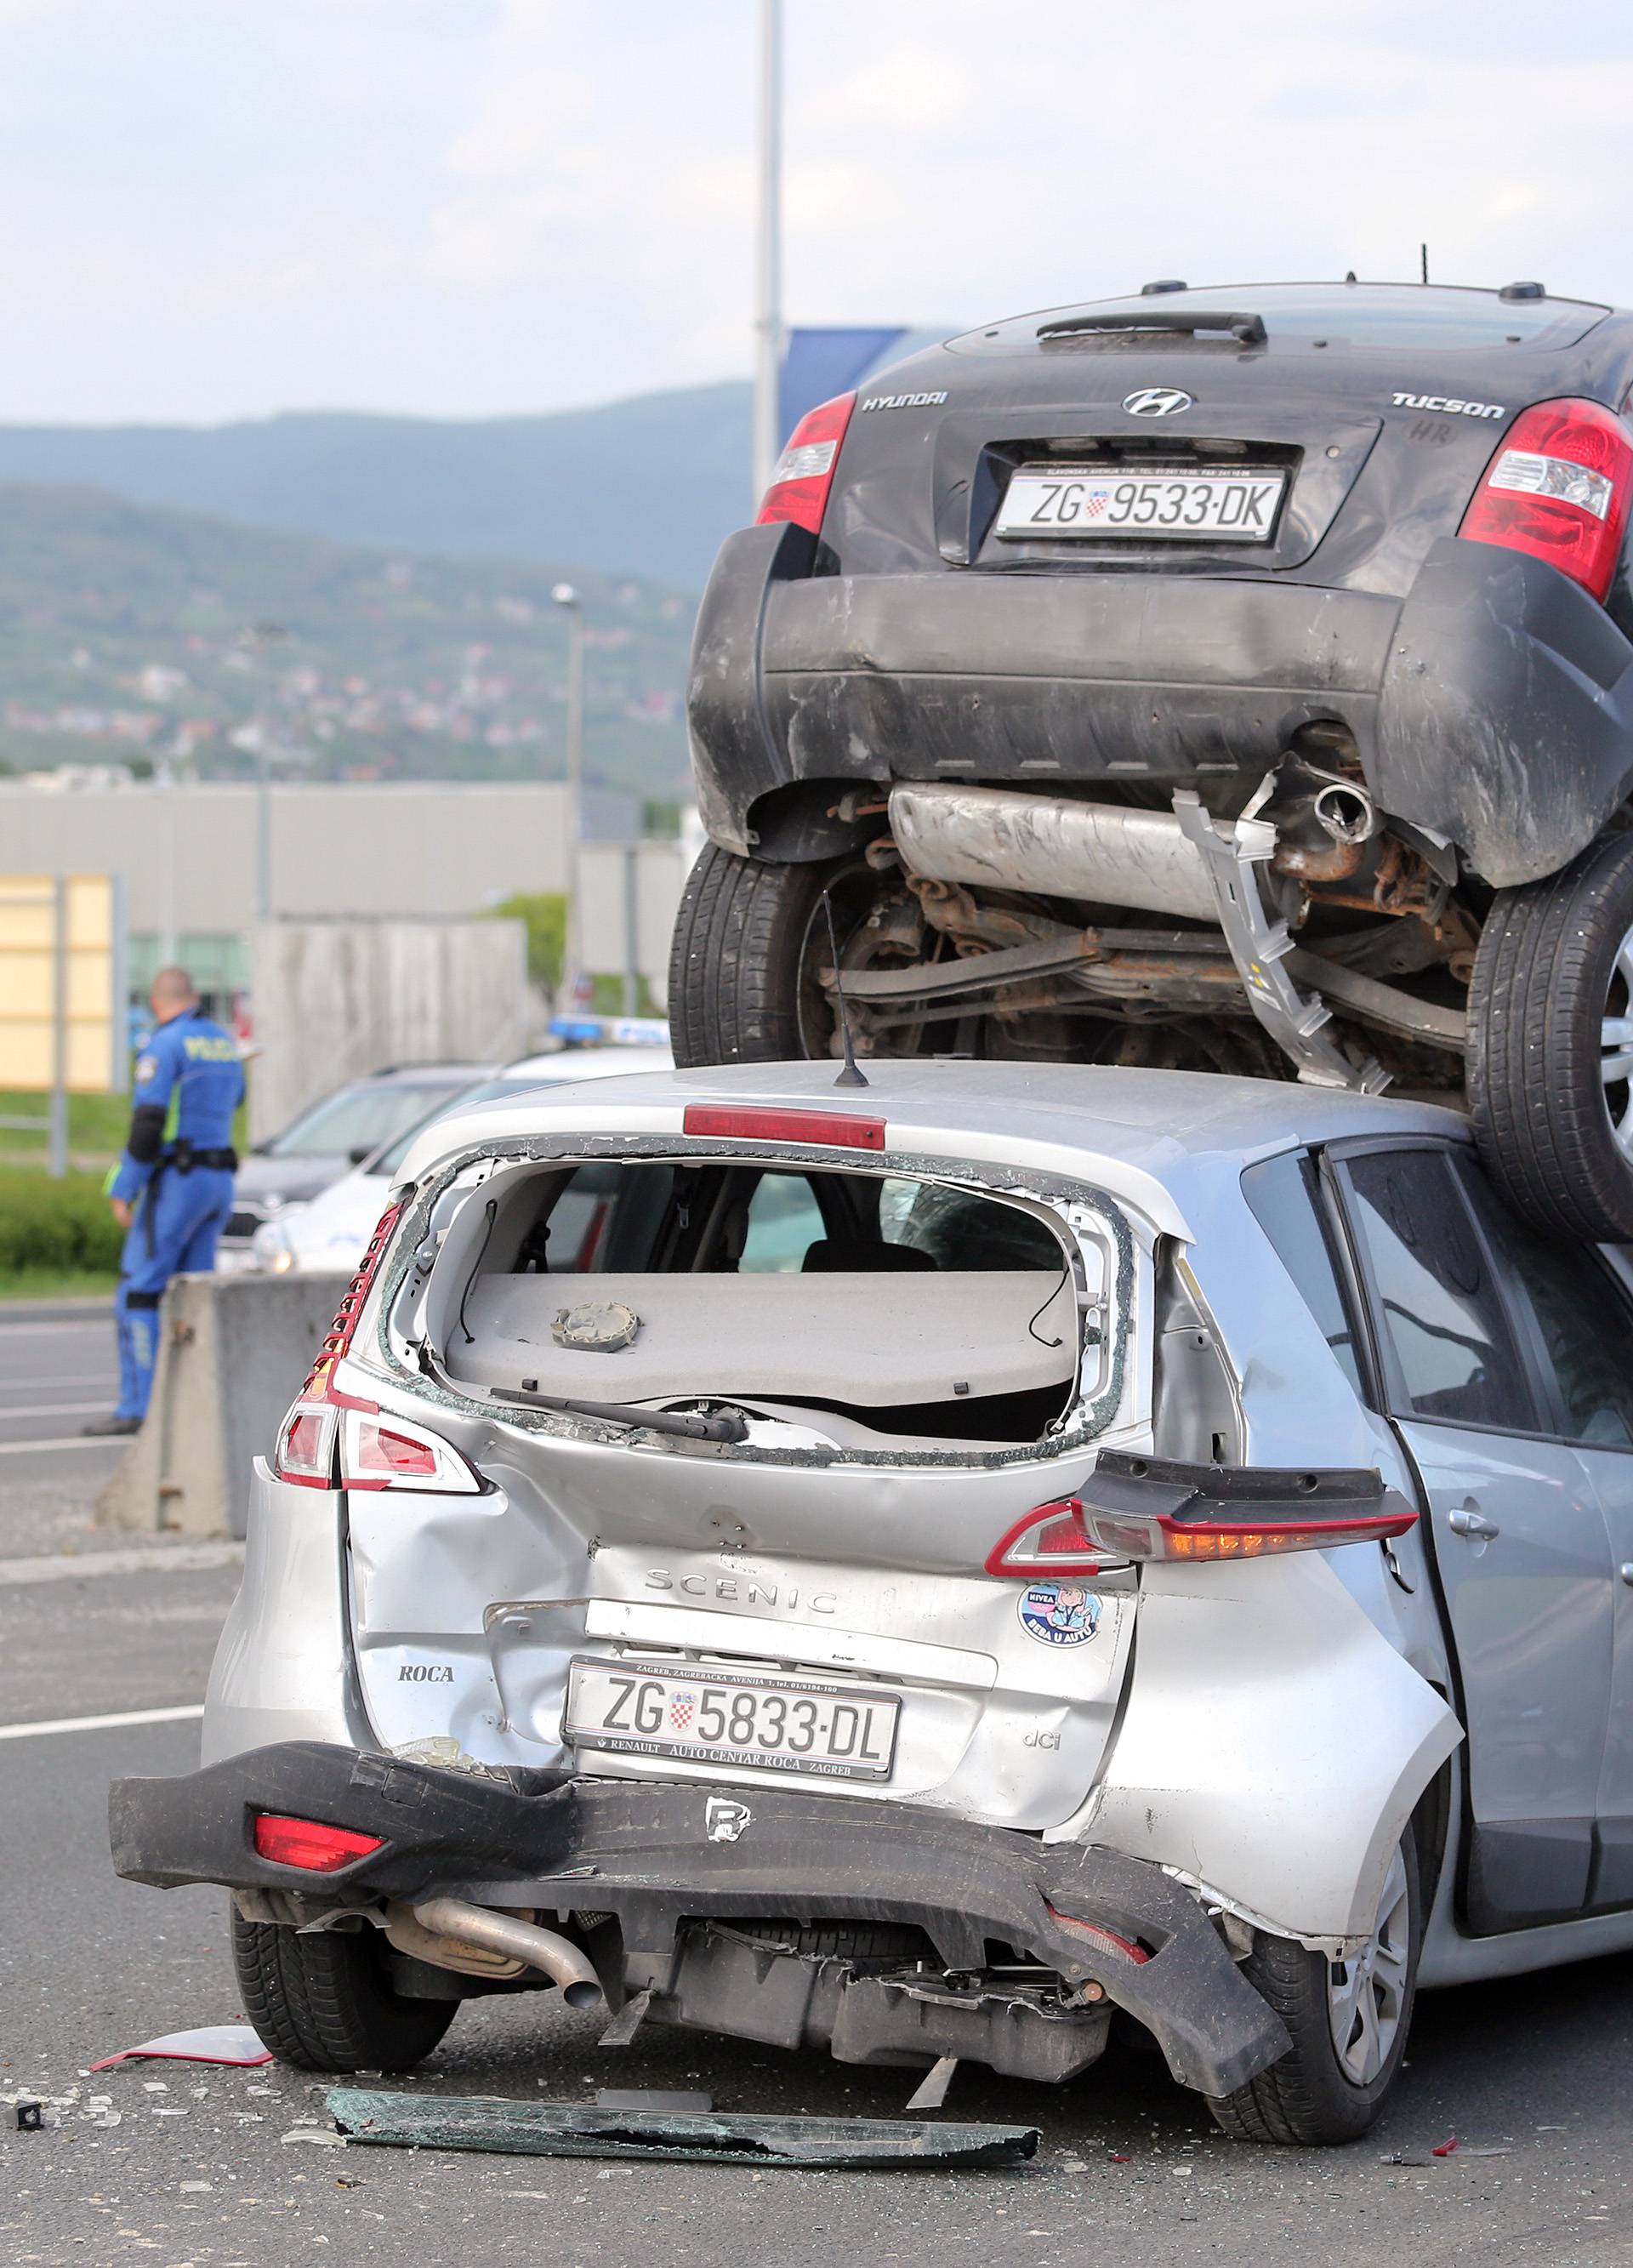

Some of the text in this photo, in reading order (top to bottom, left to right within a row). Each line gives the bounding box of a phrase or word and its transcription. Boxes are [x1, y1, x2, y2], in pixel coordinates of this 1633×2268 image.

[862, 391, 948, 412] HYUNDAI
[1409, 420, 1452, 443] HR
[1031, 484, 1085, 522] ZG
[645, 1568, 838, 1614] SCENIC
[1029, 1593, 1055, 1604] NIVEA
[1027, 1618, 1093, 1644] BEBA U AUTU
[398, 1665, 455, 1683] ROCA
[636, 1665, 672, 1677] ZAGREB,
[731, 1675, 765, 1685] AVENIJA
[603, 1678, 665, 1734] ZG
[611, 1739, 851, 1776] RENAULT AUTO CENTAR ROCA ZAGREB
